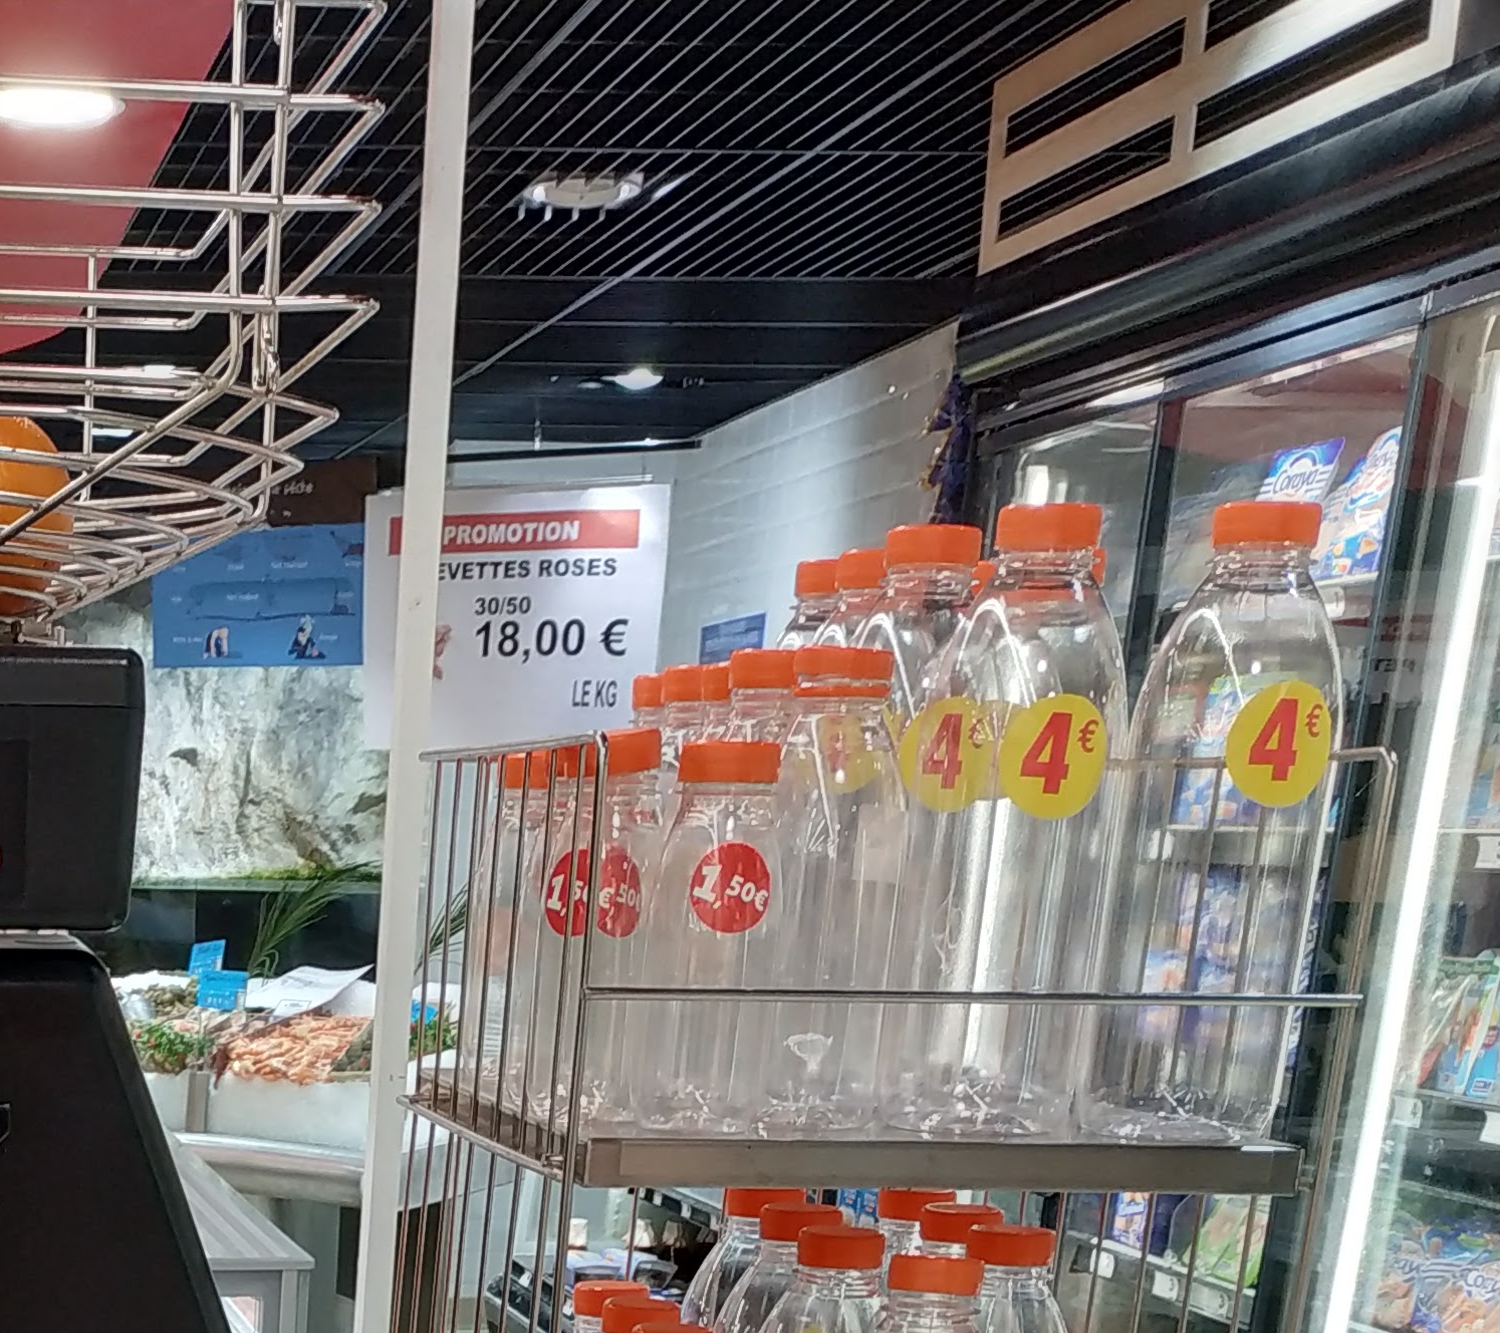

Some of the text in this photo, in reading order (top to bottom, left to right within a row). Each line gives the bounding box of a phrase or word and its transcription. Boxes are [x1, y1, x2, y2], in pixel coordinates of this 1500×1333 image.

[1271, 468, 1317, 494] Coraya
[443, 520, 580, 545] PROMOTION
[538, 558, 618, 578] ROSES
[474, 596, 532, 616] 30/50
[475, 618, 629, 664] 18,00 €
[571, 680, 618, 708] LE KG
[692, 865, 769, 911] 1,50€
